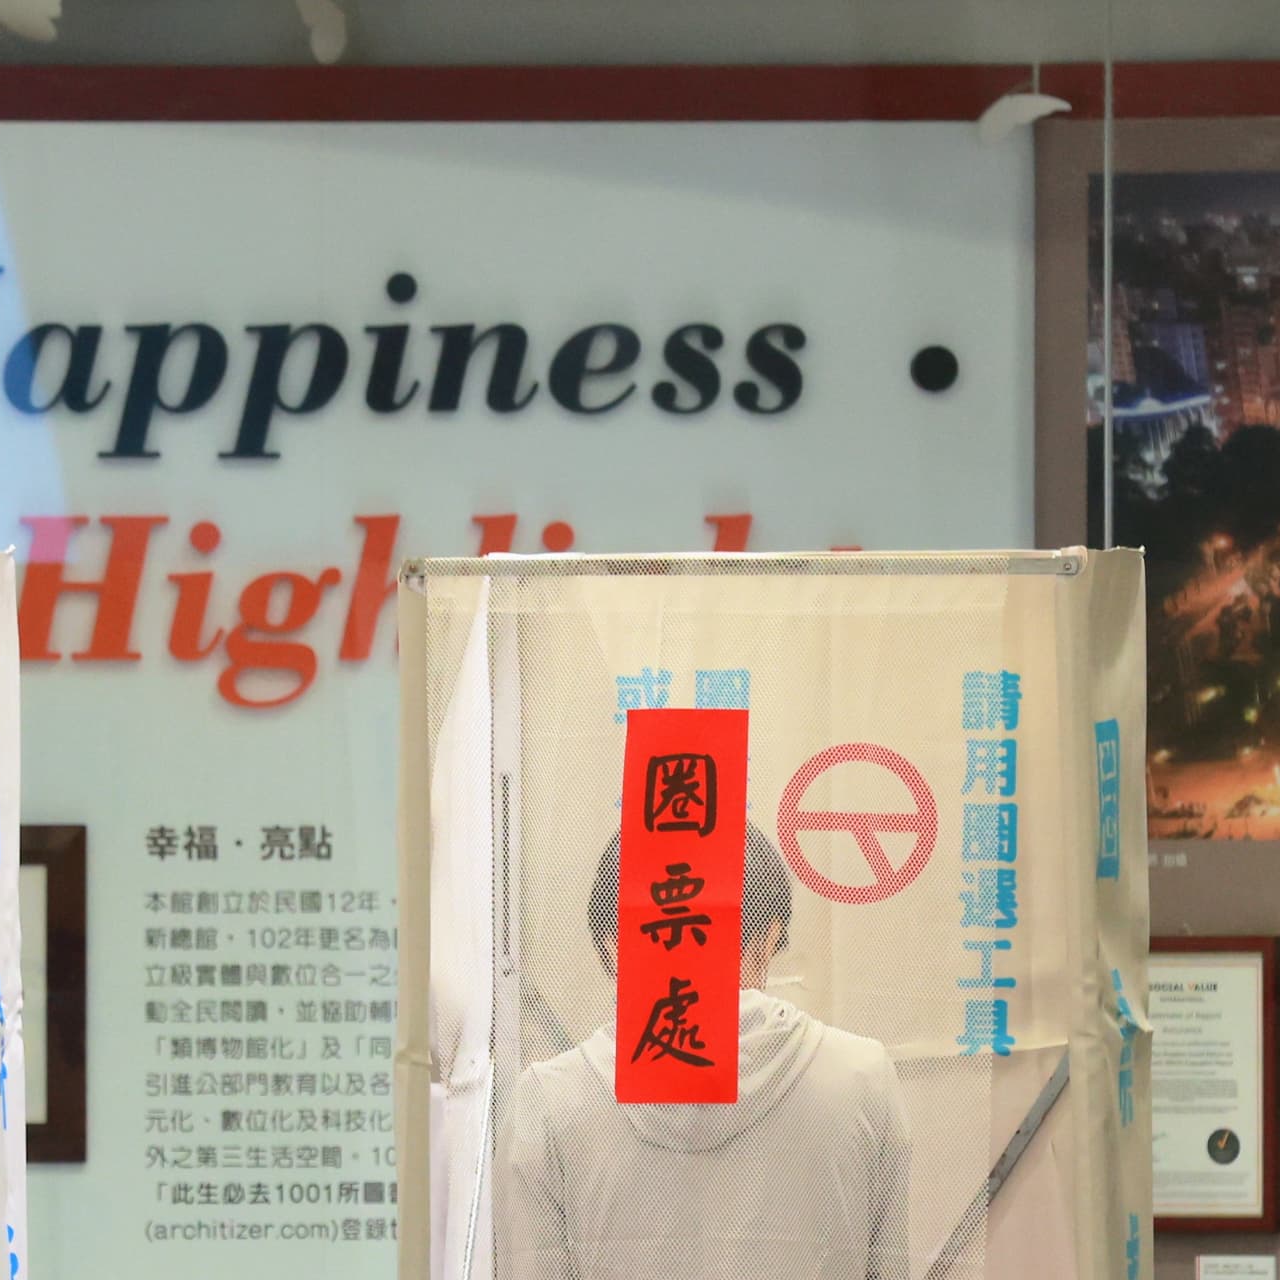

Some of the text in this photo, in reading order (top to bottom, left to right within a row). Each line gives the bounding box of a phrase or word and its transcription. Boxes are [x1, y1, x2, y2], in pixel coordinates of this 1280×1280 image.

[145, 963, 398, 987] 立級實體與數位合一之
[631, 752, 717, 1068] 圈票處
[957, 669, 1022, 1057] 請用圈選工具
